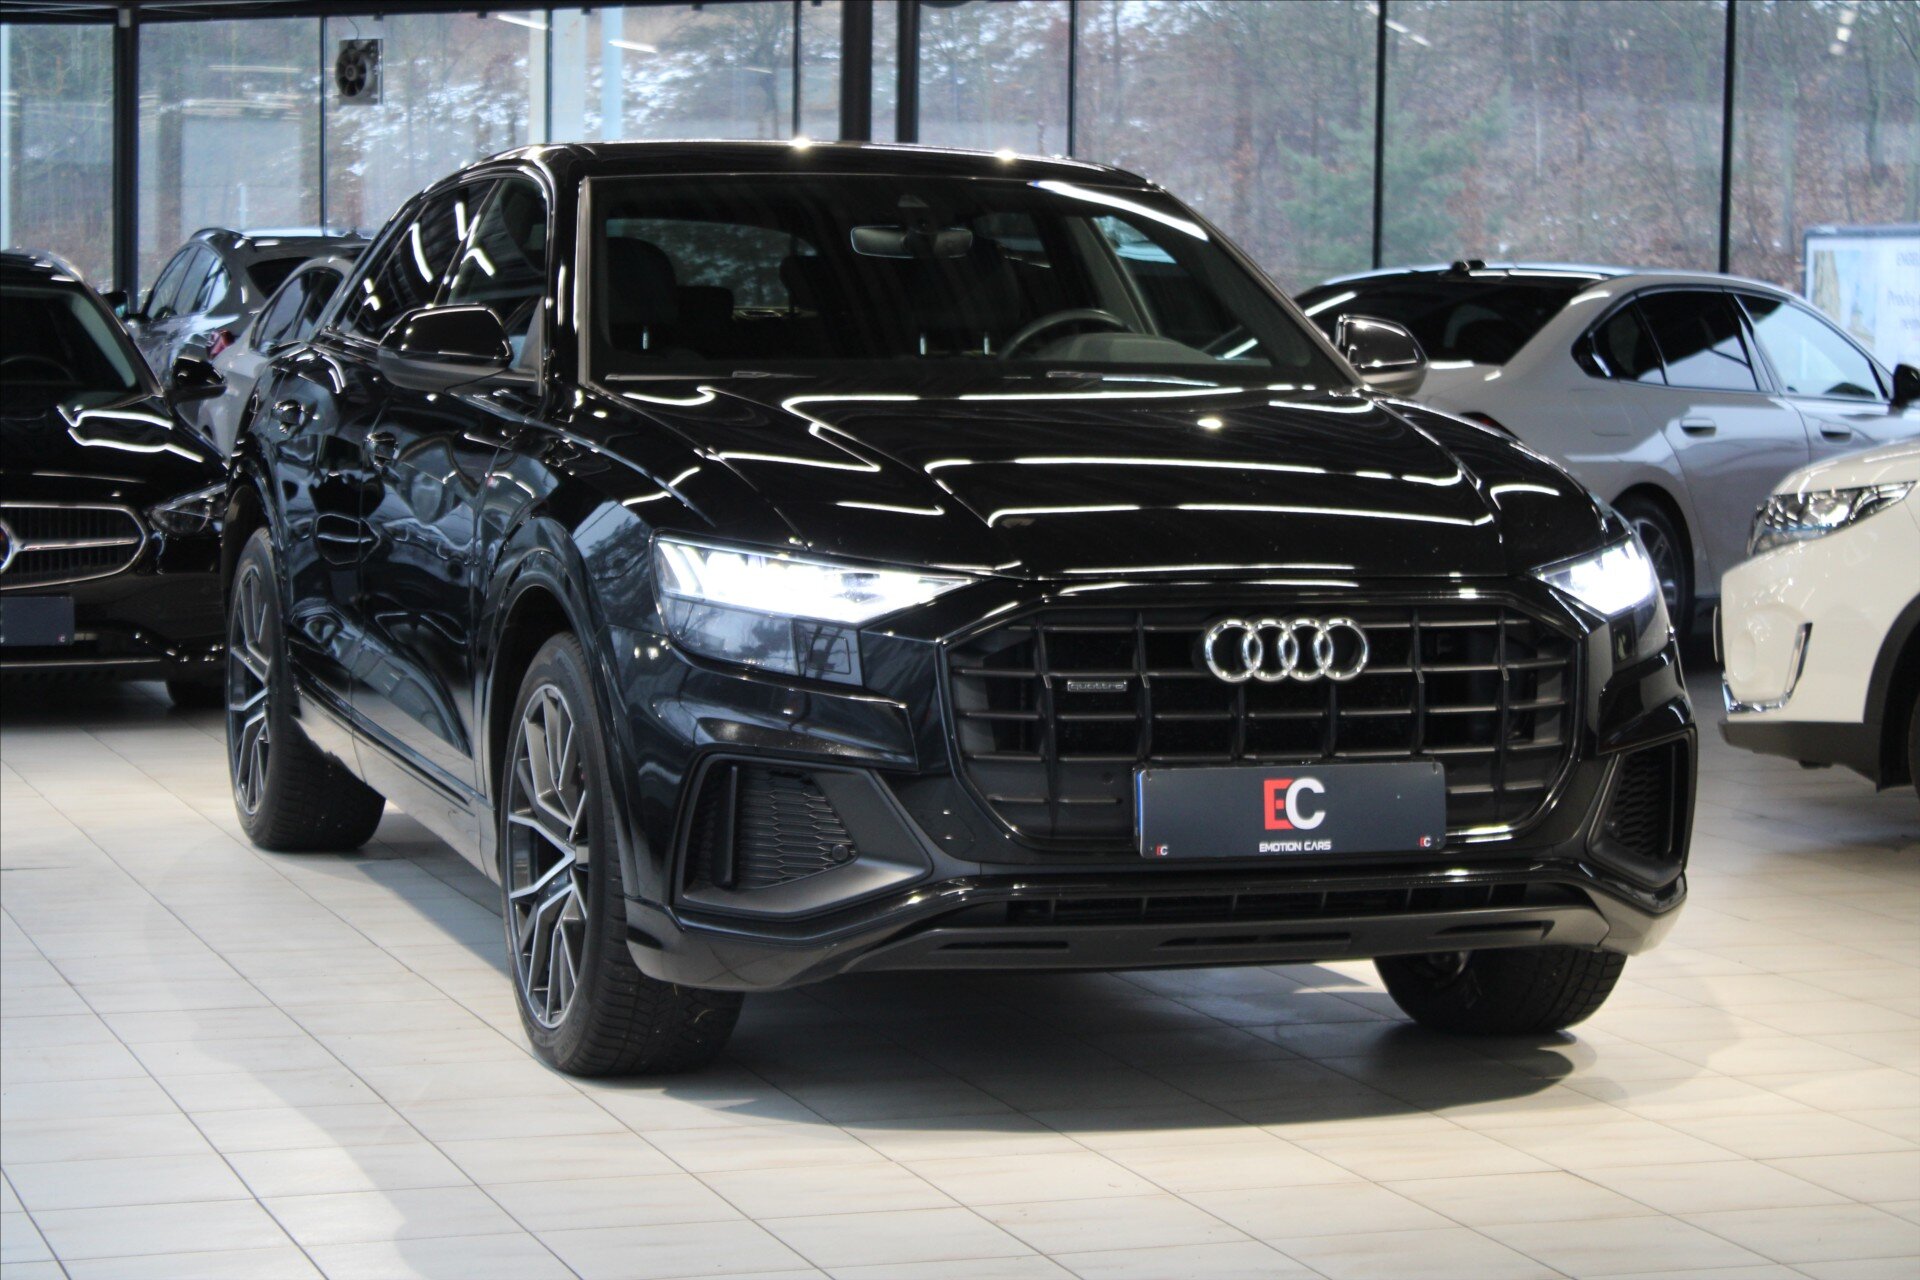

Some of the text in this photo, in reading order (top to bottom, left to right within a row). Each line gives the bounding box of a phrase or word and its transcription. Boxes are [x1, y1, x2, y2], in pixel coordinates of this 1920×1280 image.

[1263, 776, 1327, 831] EC
[1258, 840, 1332, 853] EMOTION CARS
